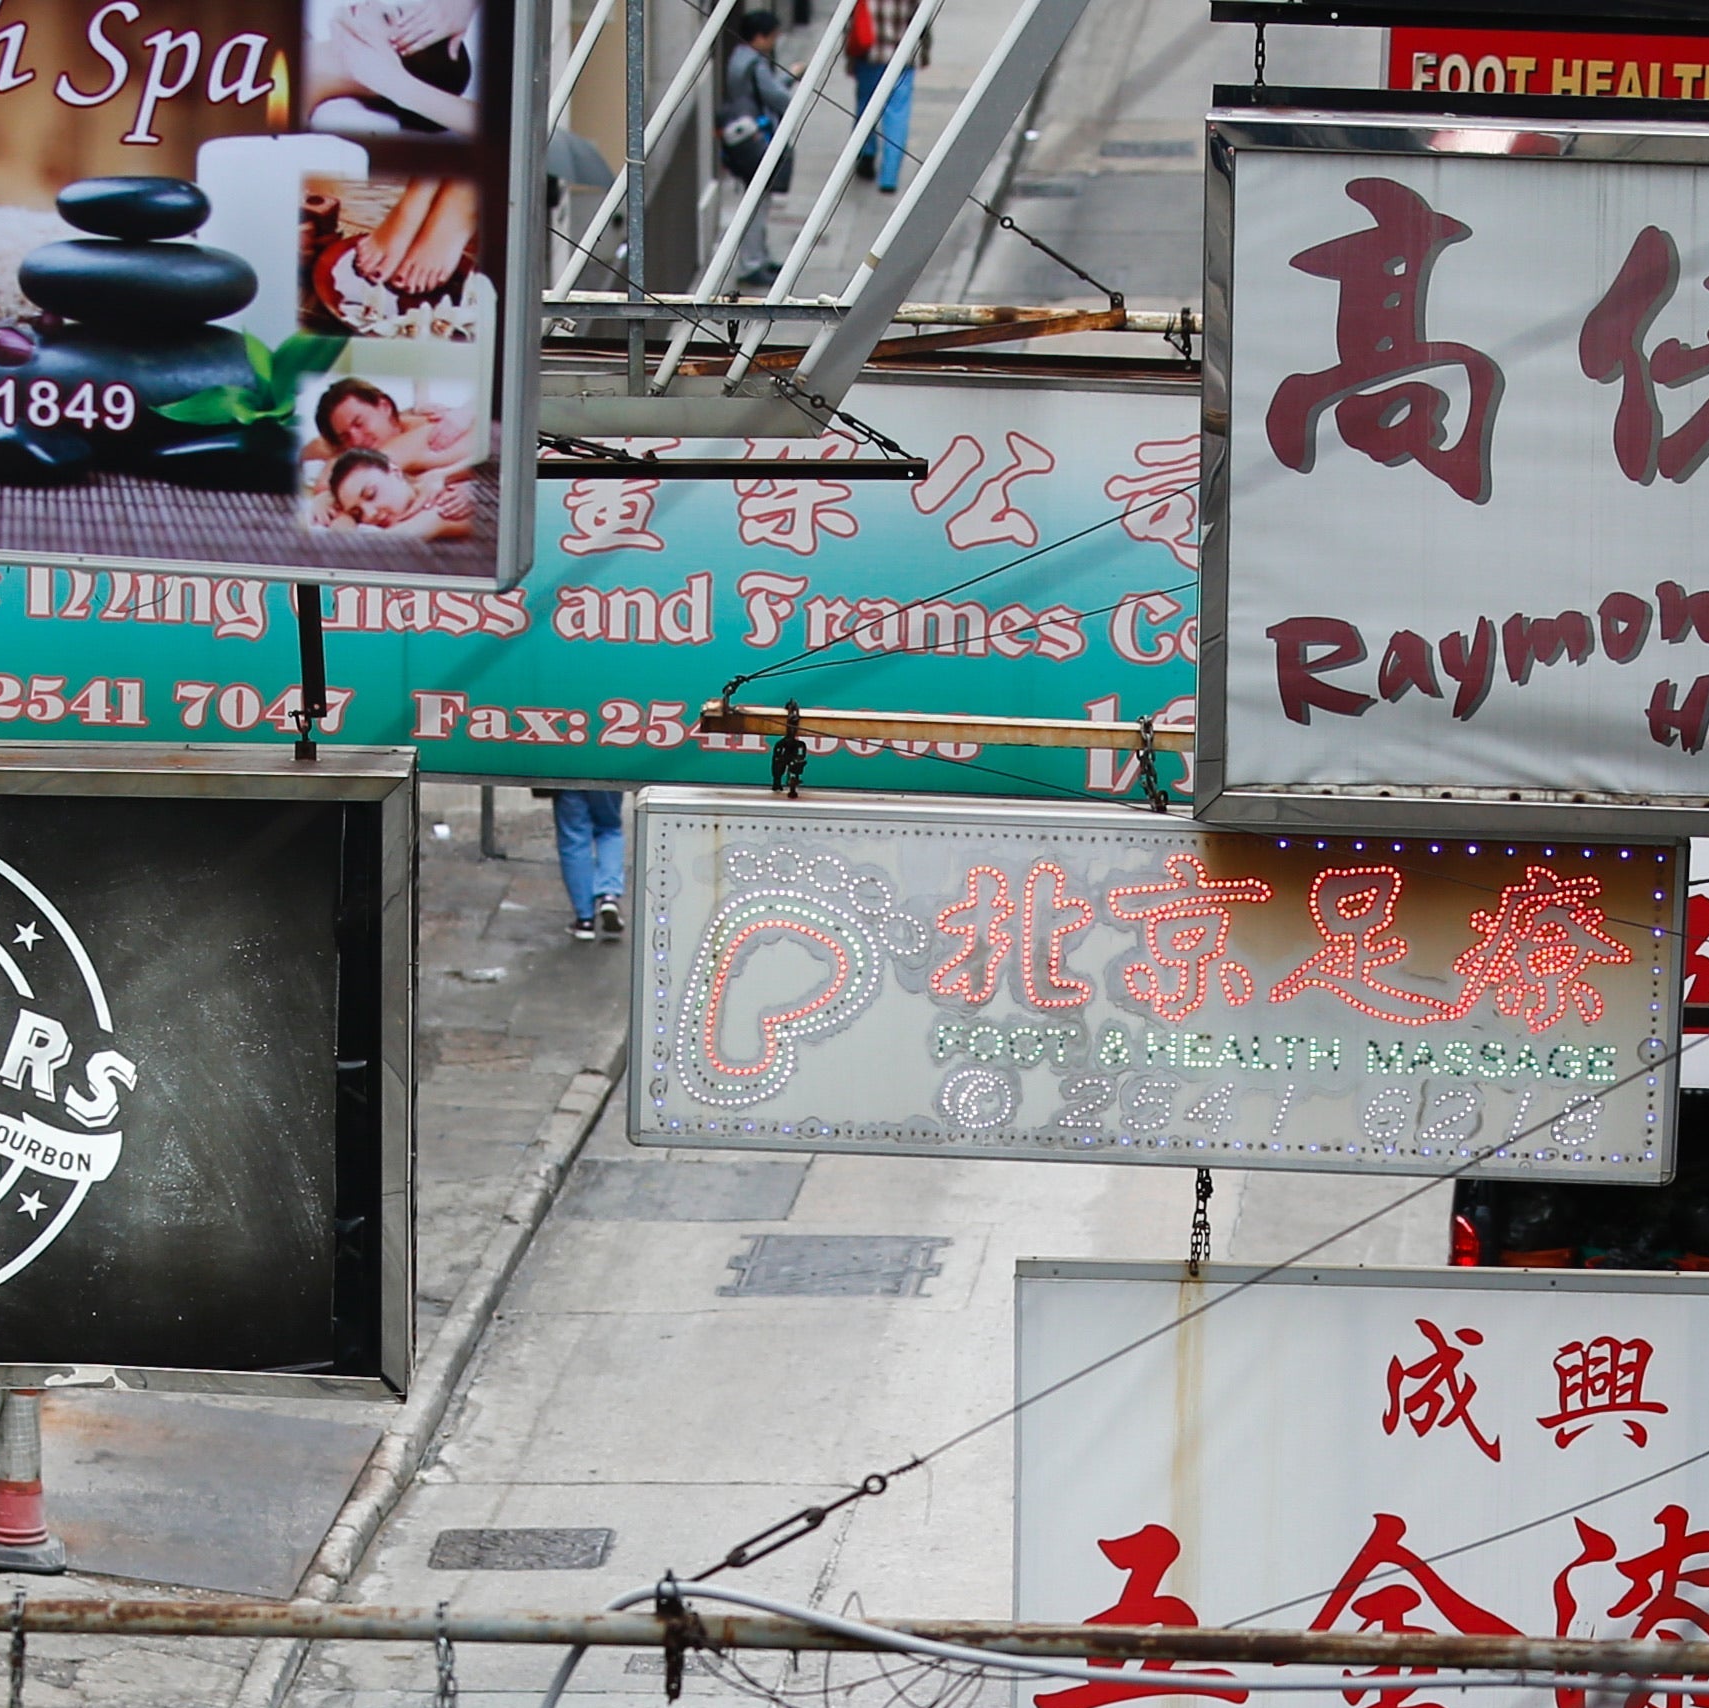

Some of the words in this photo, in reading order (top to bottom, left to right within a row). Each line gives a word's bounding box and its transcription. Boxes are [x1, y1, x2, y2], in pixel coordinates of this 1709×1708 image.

[55, 0, 277, 146] Spa
[1412, 52, 1536, 95] FOOT
[553, 572, 715, 645] and
[736, 571, 1086, 663] Frames
[929, 853, 1633, 1034] 北京足療
[936, 1023, 1076, 1063] FOOT
[1145, 1031, 1342, 1072] HEALTH
[1367, 1041, 1618, 1082] MASSAGE
[1058, 1078, 1295, 1136] 2541
[1380, 1318, 1670, 1463] 成興
